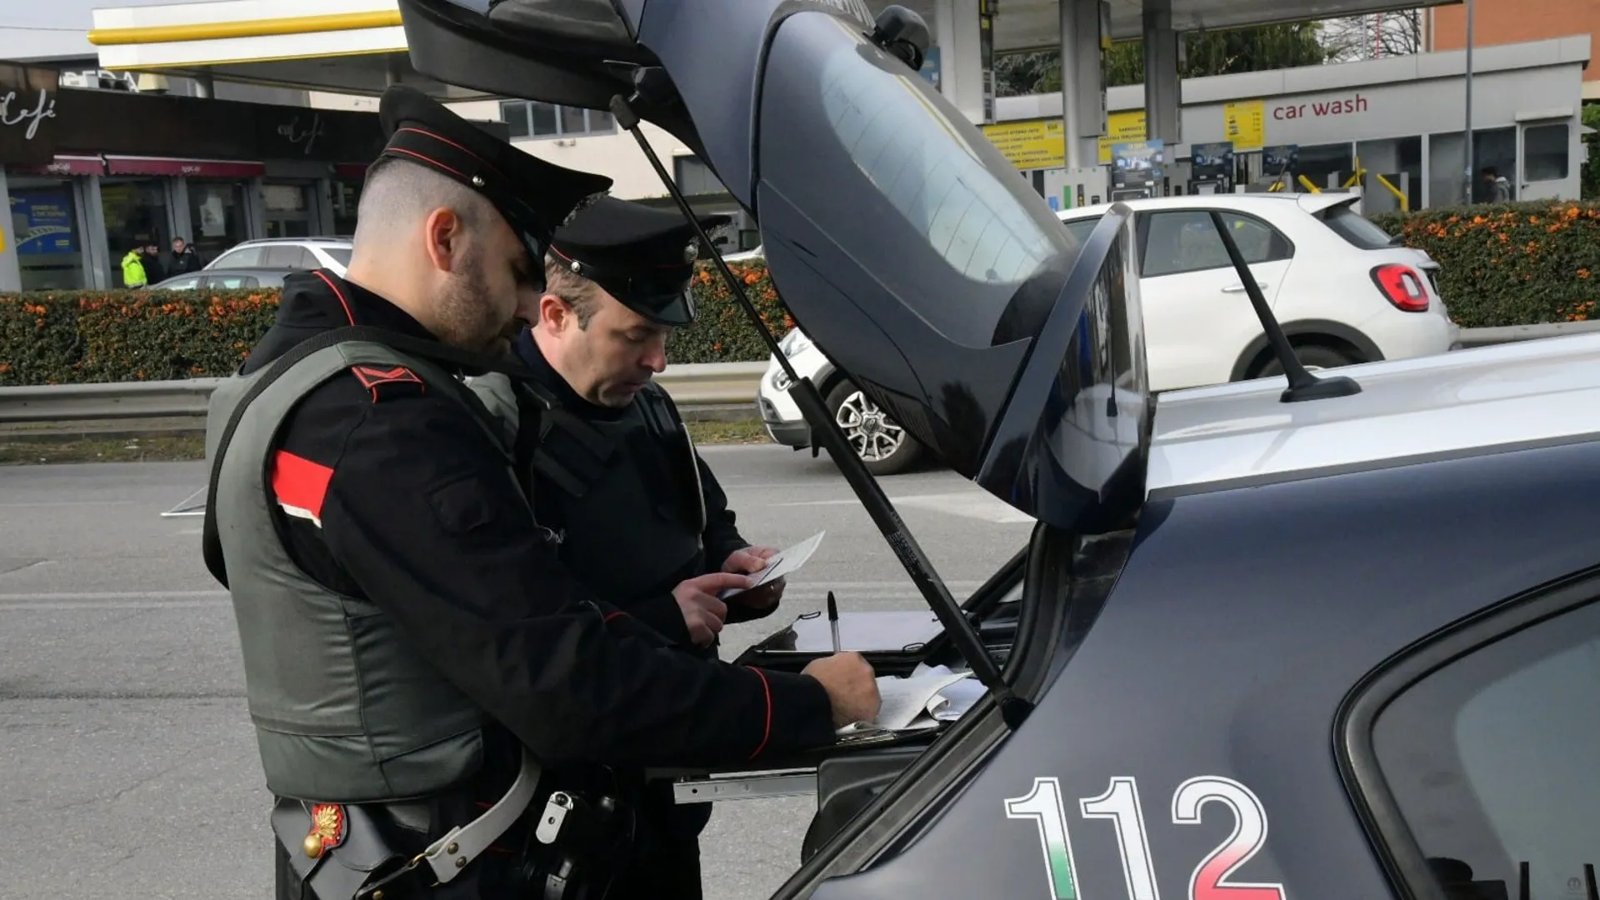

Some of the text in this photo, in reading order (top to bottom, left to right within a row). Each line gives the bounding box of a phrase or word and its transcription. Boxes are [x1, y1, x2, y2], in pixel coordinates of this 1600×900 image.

[1273, 93, 1368, 120] car wash
[1004, 775, 1286, 900] 112
